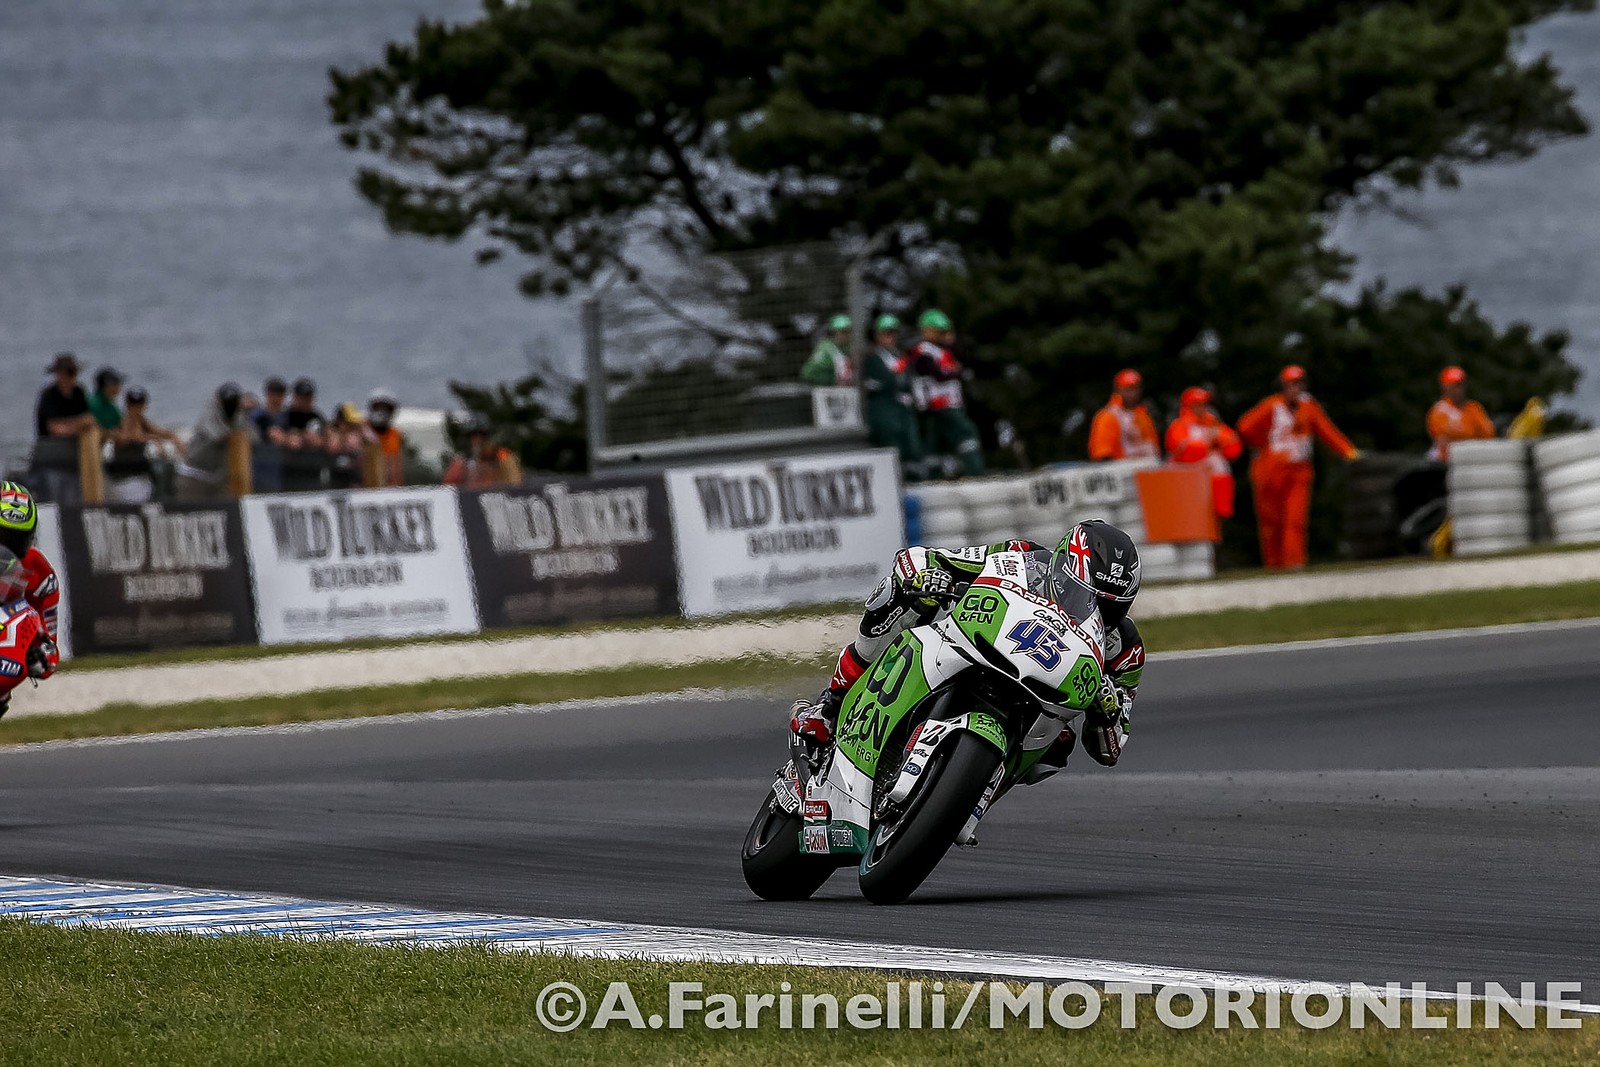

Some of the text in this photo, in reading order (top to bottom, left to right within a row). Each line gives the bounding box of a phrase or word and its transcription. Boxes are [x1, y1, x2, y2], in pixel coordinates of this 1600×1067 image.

[695, 461, 877, 531] WILD TURKEY
[1095, 572, 1129, 588] SHARK
[962, 594, 999, 613] GO
[1000, 580, 1096, 649] BARRACUDA
[959, 611, 993, 625] &FUN
[1005, 619, 1071, 673] 45
[1, 659, 21, 676] TIM
[1080, 662, 1097, 698] GO
